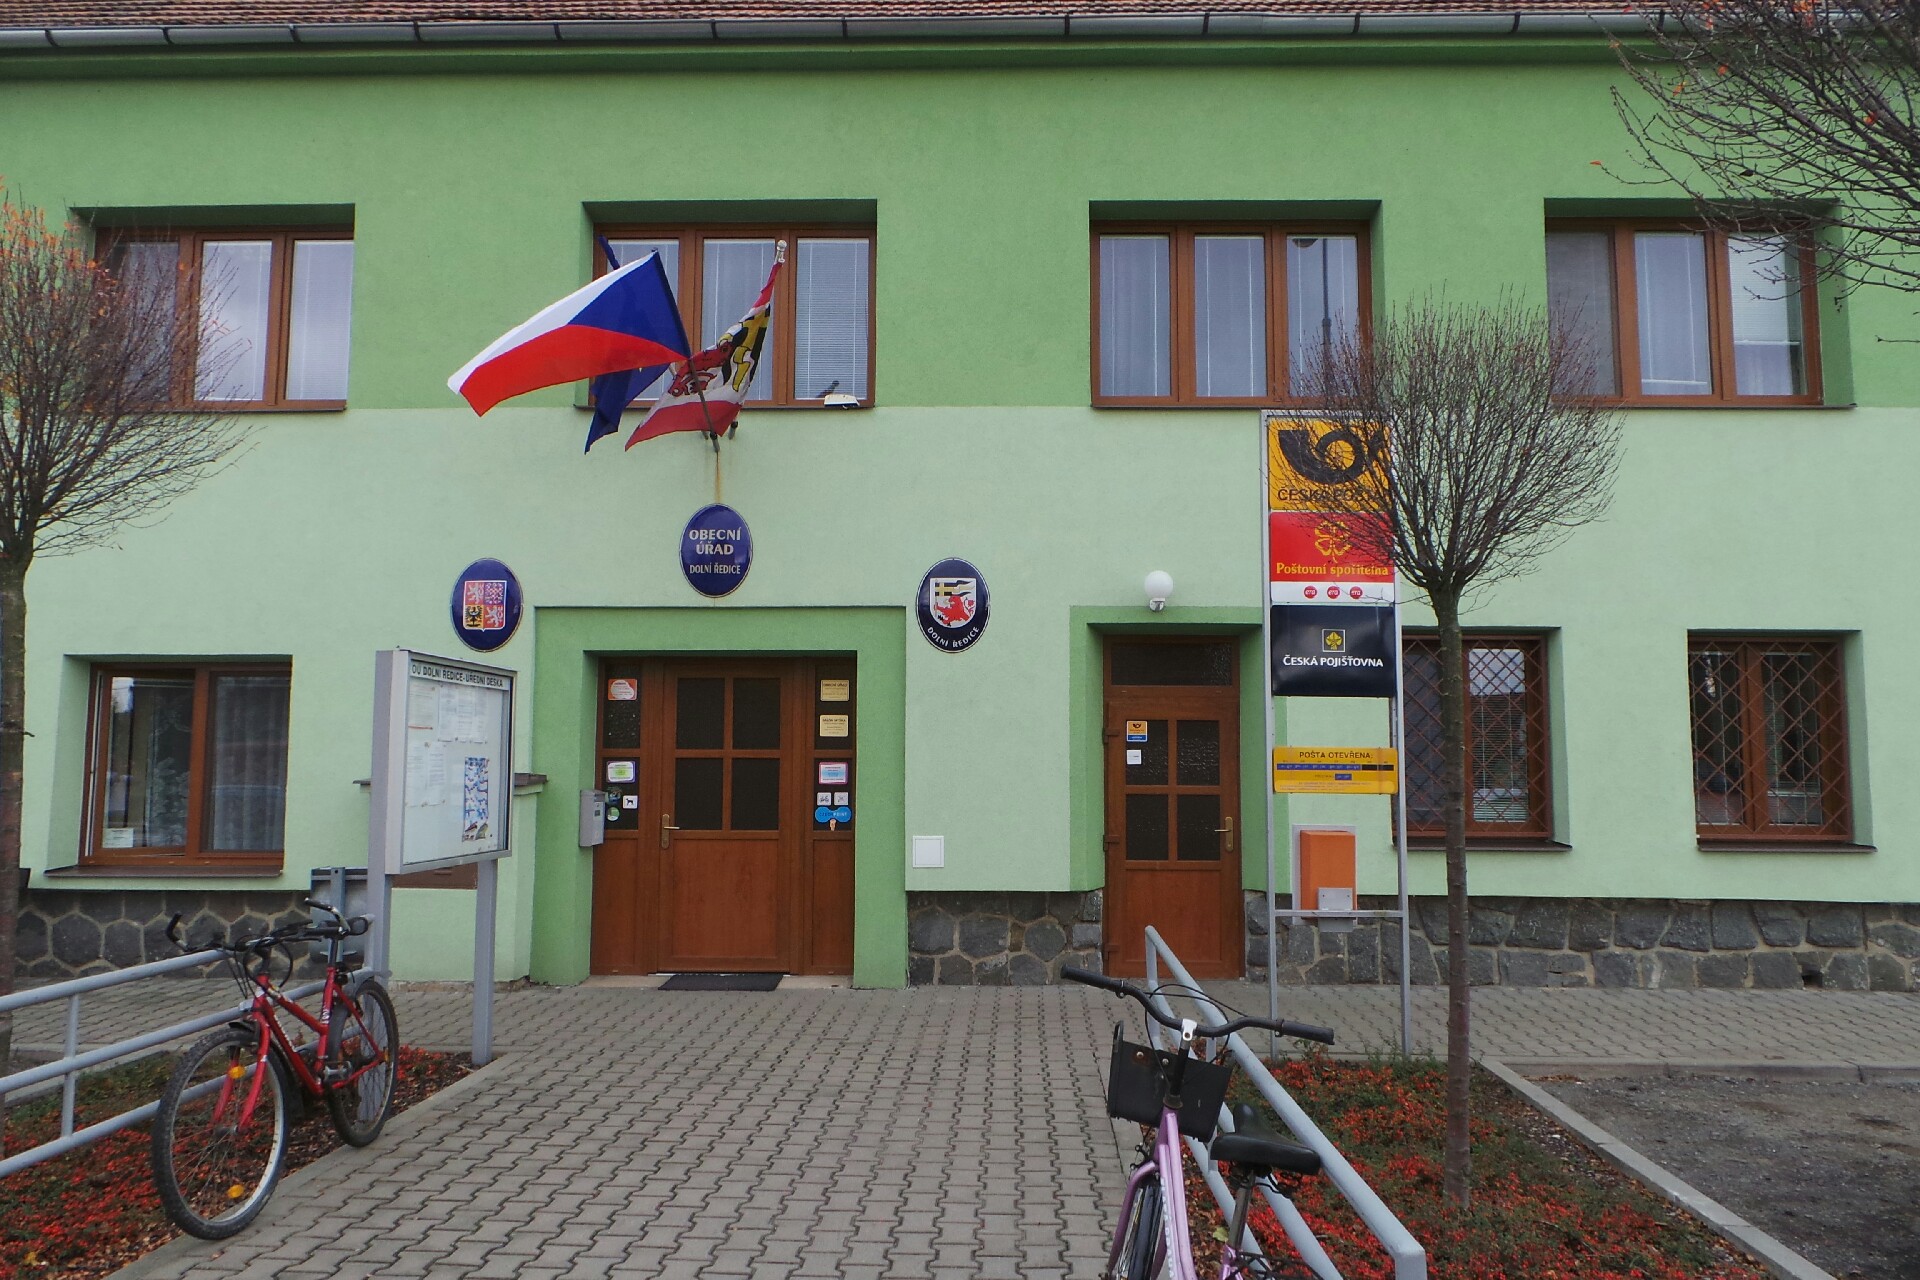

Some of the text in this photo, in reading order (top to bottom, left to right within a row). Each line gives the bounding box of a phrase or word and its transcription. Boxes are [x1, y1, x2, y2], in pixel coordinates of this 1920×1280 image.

[689, 527, 741, 541] OBECNÍ
[696, 541, 734, 555] ÚŘAD
[689, 562, 741, 575] DOLNÍ ŘEDICE
[1276, 562, 1327, 575] Poštovní
[927, 626, 980, 648] DOLNÍ ŘEDICE
[1283, 654, 1384, 667] ČESKÁ POJIŠŤOVNA
[486, 676, 504, 687] DESKA
[1299, 750, 1374, 759] POŠTA OTEVŘENA:
